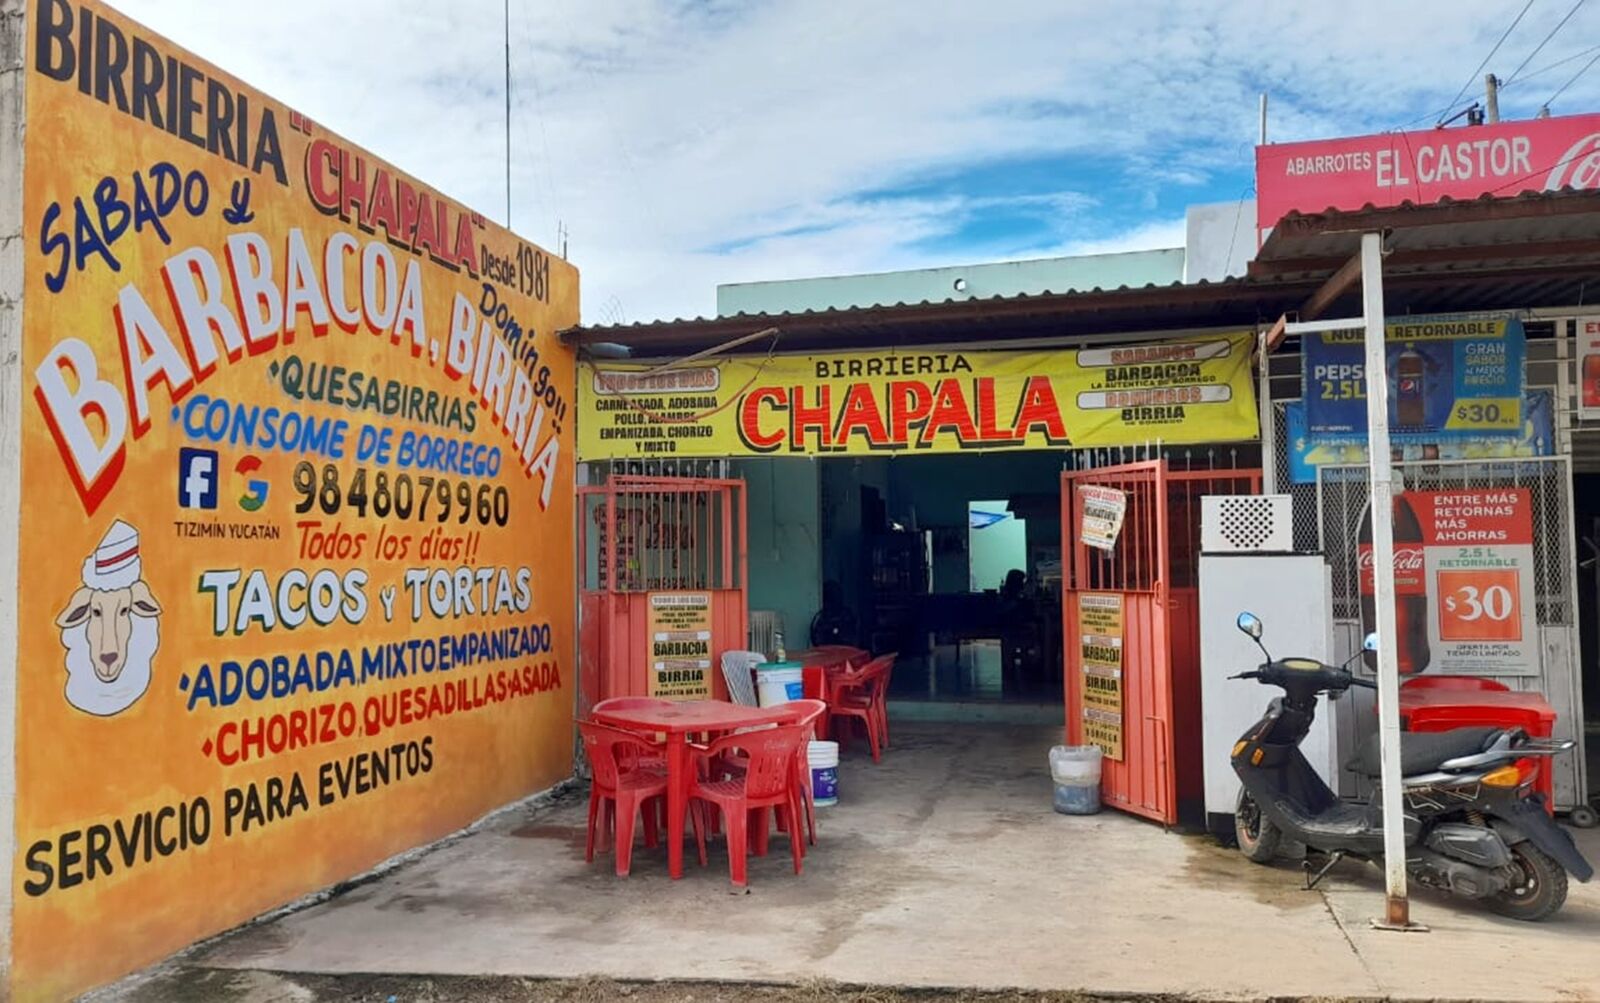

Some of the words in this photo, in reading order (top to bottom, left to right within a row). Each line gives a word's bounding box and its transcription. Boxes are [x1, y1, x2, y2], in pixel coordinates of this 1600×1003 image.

[35, 0, 289, 187] BIRRIERIA
[481, 244, 517, 288] Desde
[517, 242, 550, 305] 1981
[1286, 151, 1372, 176] ABARROTES
[1376, 149, 1409, 187] EL
[1416, 136, 1532, 183] CASTOR
[40, 162, 210, 293] SABADO
[1395, 322, 1496, 338] RETORNABLE
[479, 283, 566, 434] Domingo!!
[1465, 343, 1506, 354] GRAN
[815, 354, 973, 378] BIRRIERIA
[1105, 364, 1201, 382] BARBACOA
[1314, 365, 1366, 380] PEPS
[281, 355, 477, 433] QUESABIRRIAS
[444, 292, 560, 512] BIRRIA
[595, 399, 630, 411] CARNE
[668, 396, 718, 409] ADOBADA
[735, 375, 1073, 453] CHAPALA
[1121, 406, 1185, 421] BIRRIA
[183, 394, 349, 459] CONSOME
[356, 425, 393, 464] DE
[397, 431, 502, 477] BORREGO
[667, 425, 713, 438] CHORIZO
[635, 441, 642, 453] Y
[643, 440, 677, 453] MIXTO
[293, 461, 510, 527] 9848079960
[1434, 494, 1481, 505] ENTRE
[1485, 491, 1519, 504] MÁS
[1434, 505, 1514, 517] RETORNAS
[173, 516, 225, 538] TIZIMÍN
[228, 519, 280, 540] YUCATÁN
[1434, 517, 1467, 529] MÁS
[296, 521, 367, 560] Todos
[374, 524, 412, 561] los
[1435, 530, 1507, 541] AHORRAS
[1439, 558, 1518, 568] RETORNABLE
[198, 568, 369, 636] TACOS
[404, 566, 532, 621] TORTAS
[1445, 585, 1513, 622] $30
[653, 641, 708, 656] BARBACOA
[658, 670, 704, 683] BIRRIA
[24, 796, 211, 897] SERVICIO
[223, 771, 309, 837] PARA
[318, 736, 434, 806] EVENTOS
